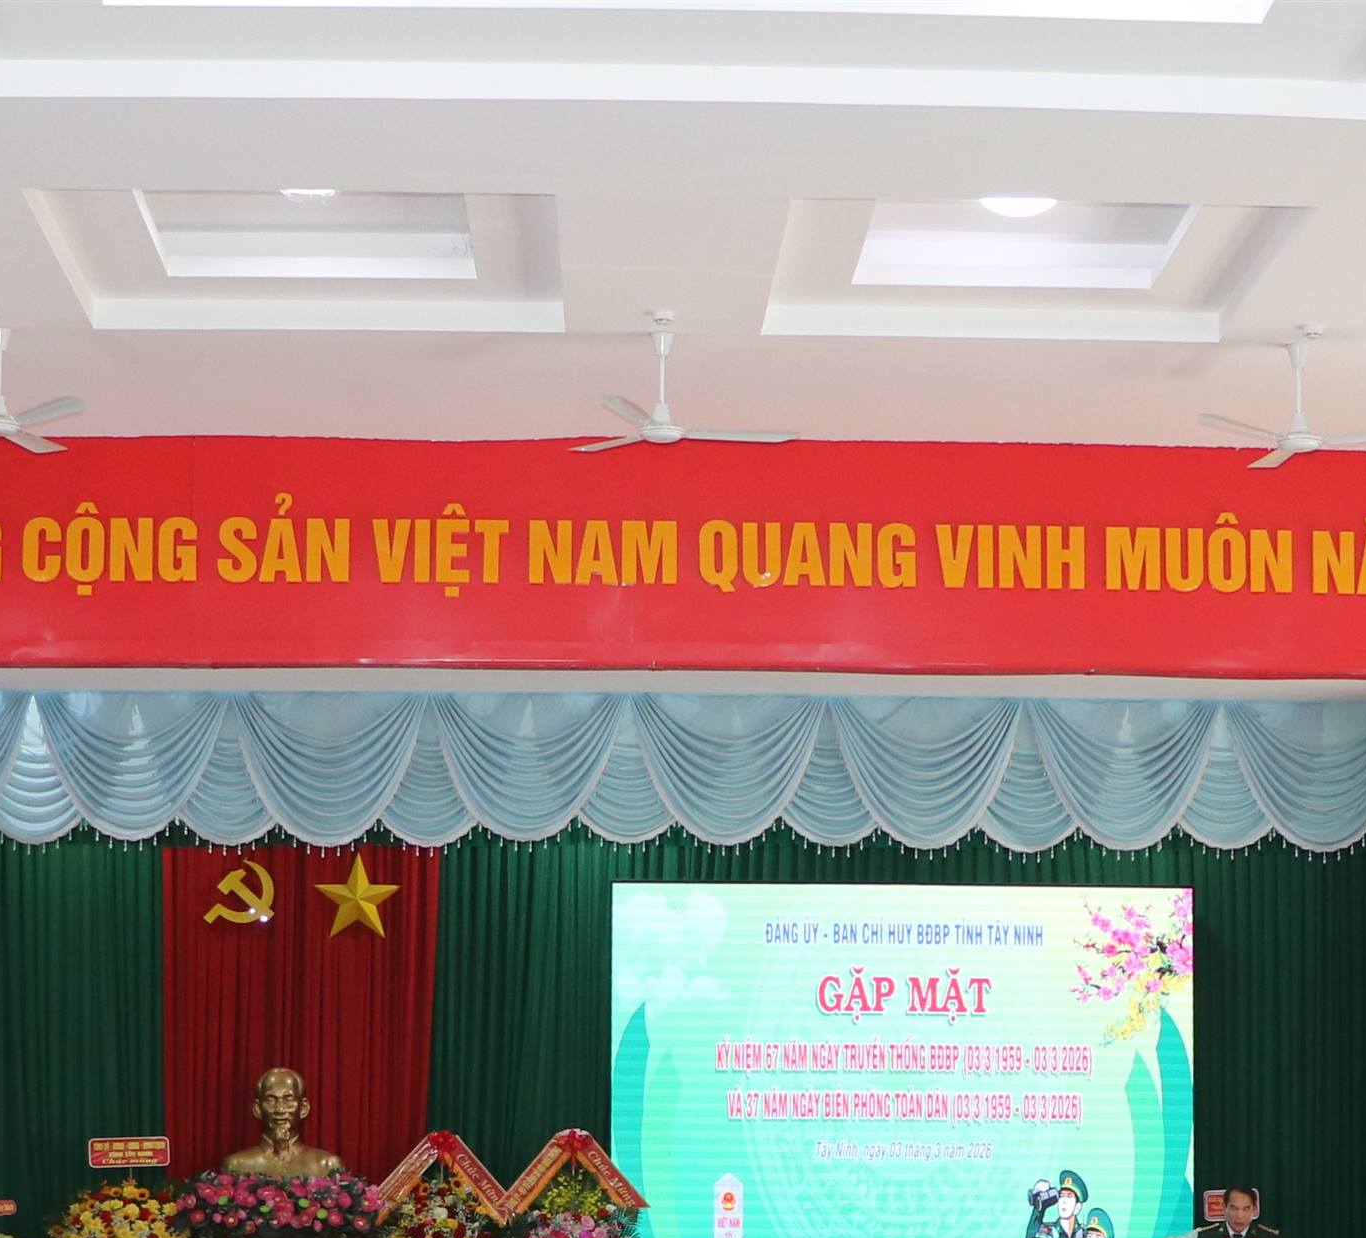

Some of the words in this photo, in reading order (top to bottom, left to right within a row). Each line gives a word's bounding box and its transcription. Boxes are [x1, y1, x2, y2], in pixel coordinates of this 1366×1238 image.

[23, 502, 197, 595] CỘNG
[217, 493, 349, 582] SẢN
[373, 504, 509, 598] VIỆT
[529, 520, 677, 587] NAM
[699, 520, 916, 592] QUANG
[935, 525, 1085, 589] VINH
[1106, 512, 1292, 592] MUÔN
[833, 923, 857, 944] BAN
[888, 923, 912, 945] HUY
[917, 923, 950, 945] BĐBP
[987, 919, 1009, 946] TÂY
[1014, 925, 1043, 946] NINH
[817, 966, 895, 1022] GẶP
[908, 967, 992, 1022] MẶT
[766, 1045, 779, 1069] 67
[930, 1045, 959, 1070] BĐBP
[746, 1093, 759, 1117] 37
